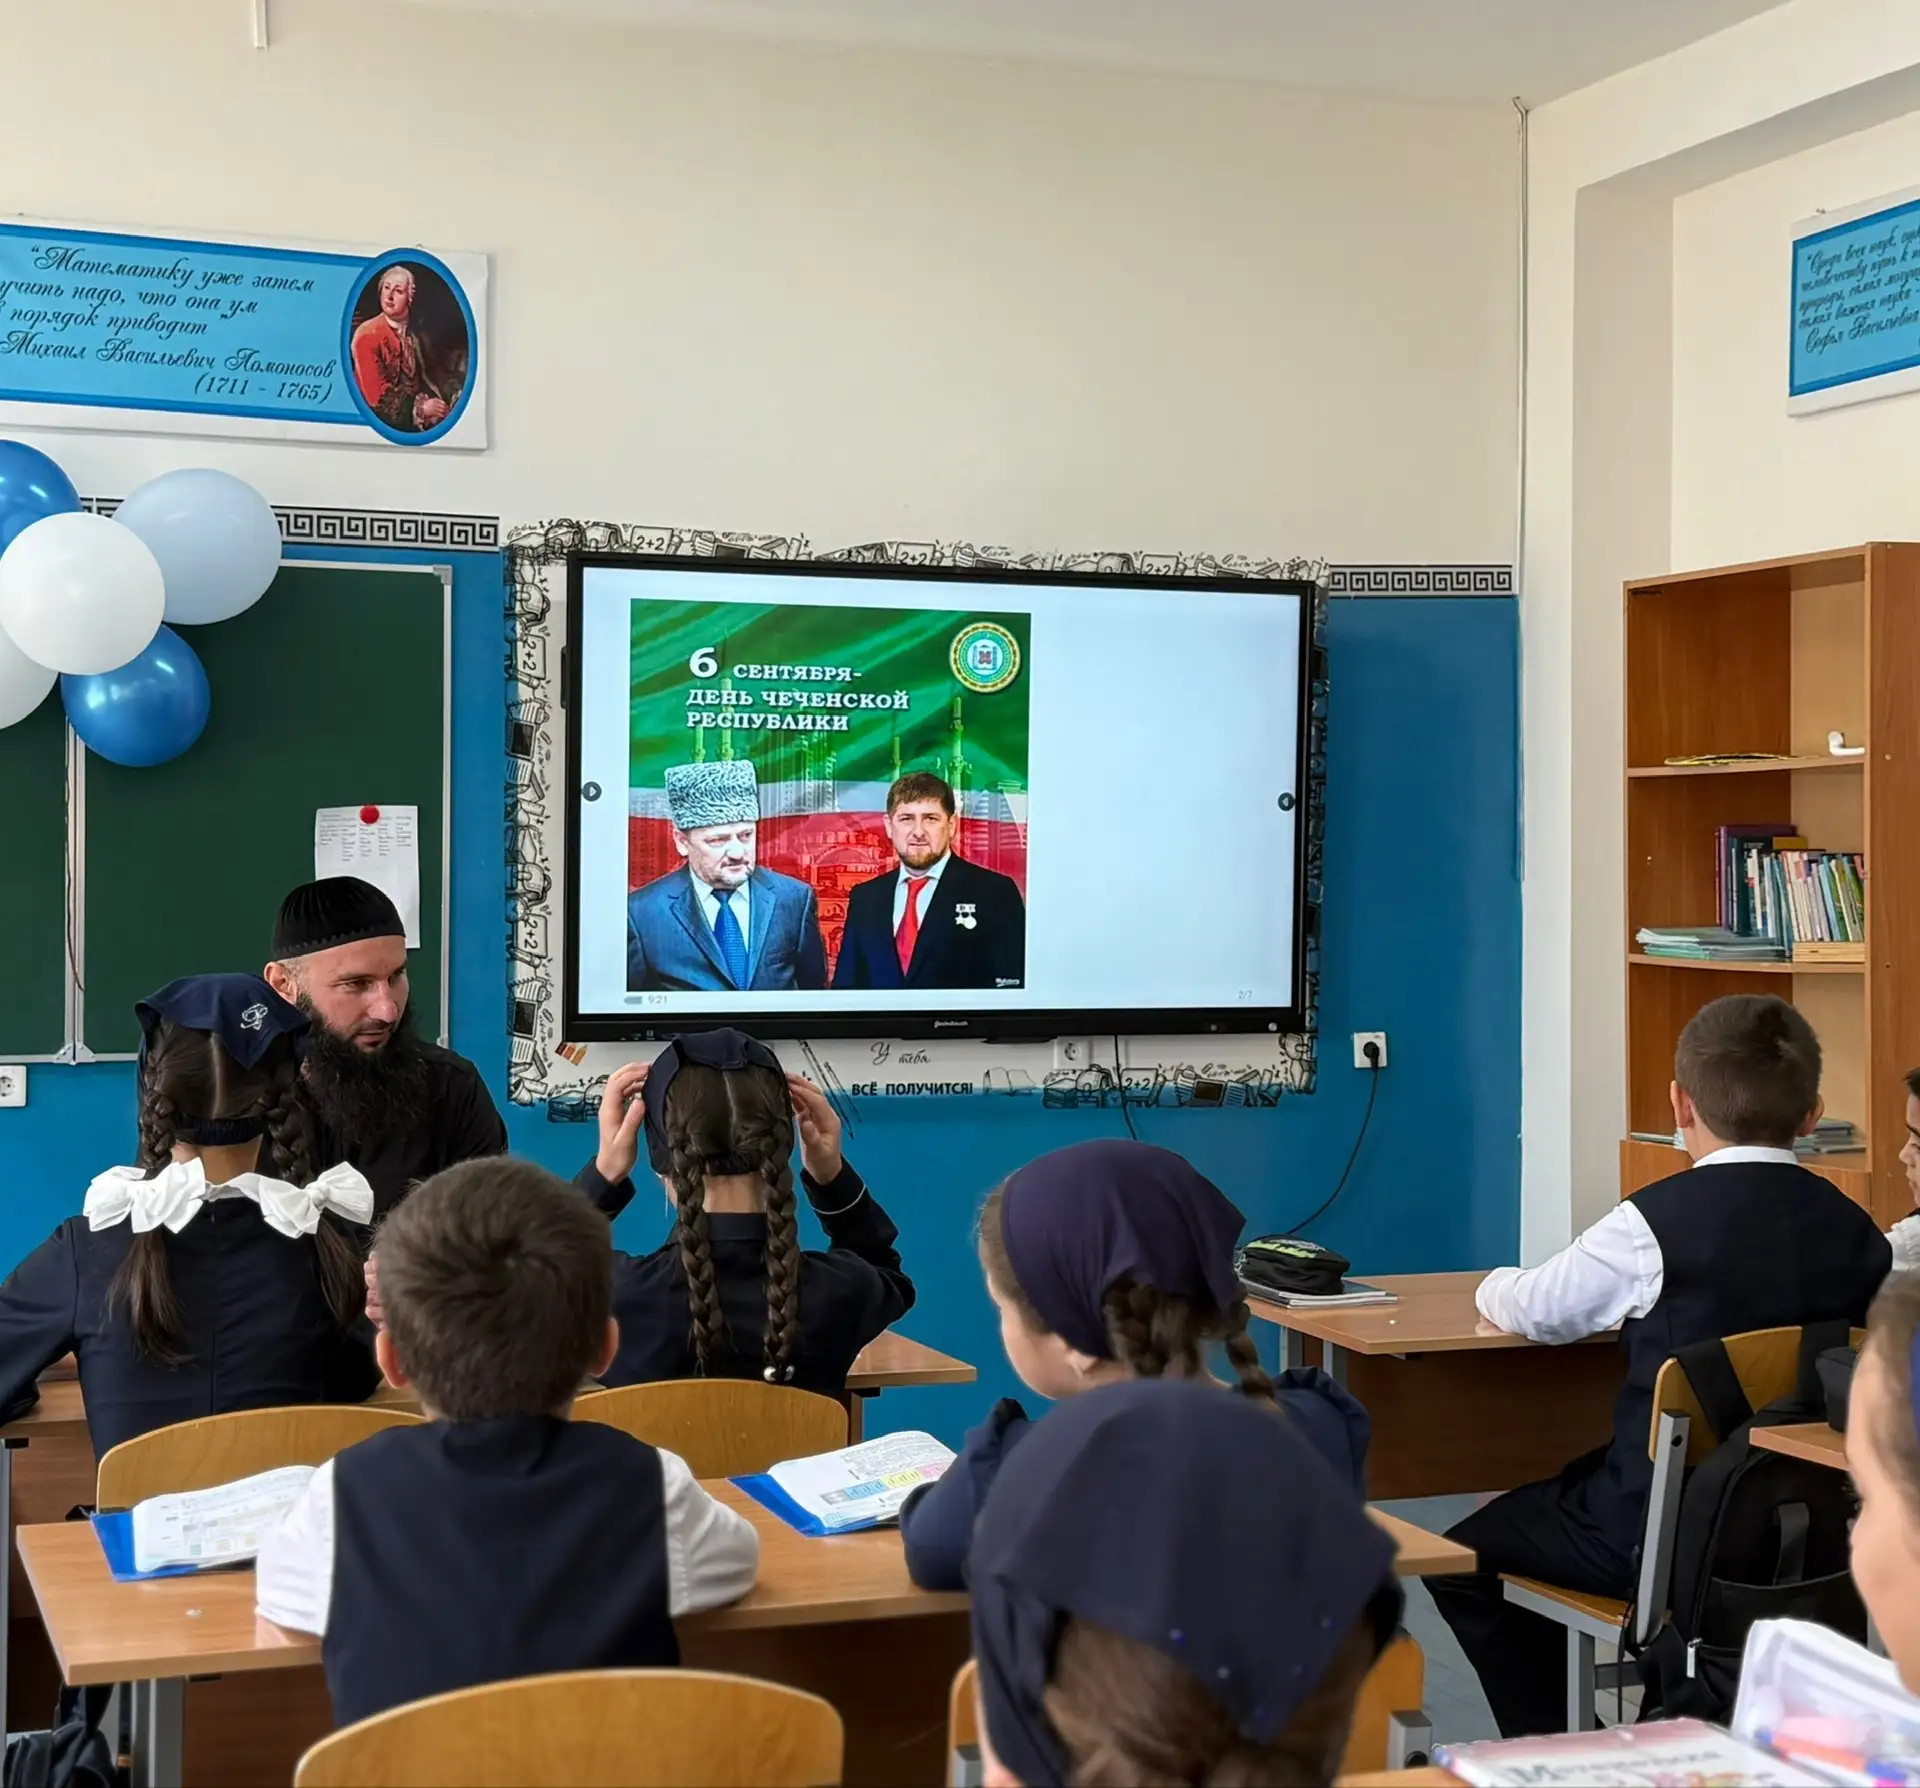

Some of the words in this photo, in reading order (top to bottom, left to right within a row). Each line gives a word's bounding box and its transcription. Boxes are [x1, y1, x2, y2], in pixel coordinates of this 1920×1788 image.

[194, 270, 245, 291] уже
[252, 275, 315, 292] затем
[72, 285, 126, 308] надо,
[139, 291, 178, 307] что
[185, 295, 222, 310] она
[223, 299, 259, 320] ум
[10, 302, 106, 332] порядок
[0, 330, 87, 360] Михаил
[96, 338, 215, 369] Васильевич
[224, 348, 337, 379] Ломоносов
[194, 372, 249, 395] (1711
[277, 382, 332, 404] 1765)
[689, 647, 718, 678] 6
[733, 663, 863, 682] СЕНТЯБРЯ-
[686, 688, 754, 706] ДЕНЬ
[761, 689, 910, 710] ЧЕЧЕНСКОЙ
[686, 711, 849, 731] РЕСПУБЛИКИ
[870, 1041, 891, 1066] У
[898, 1048, 932, 1064] тебя
[851, 1081, 878, 1096] ВСЁ
[885, 1082, 973, 1096] ПОЛУЧИТСЯ!
